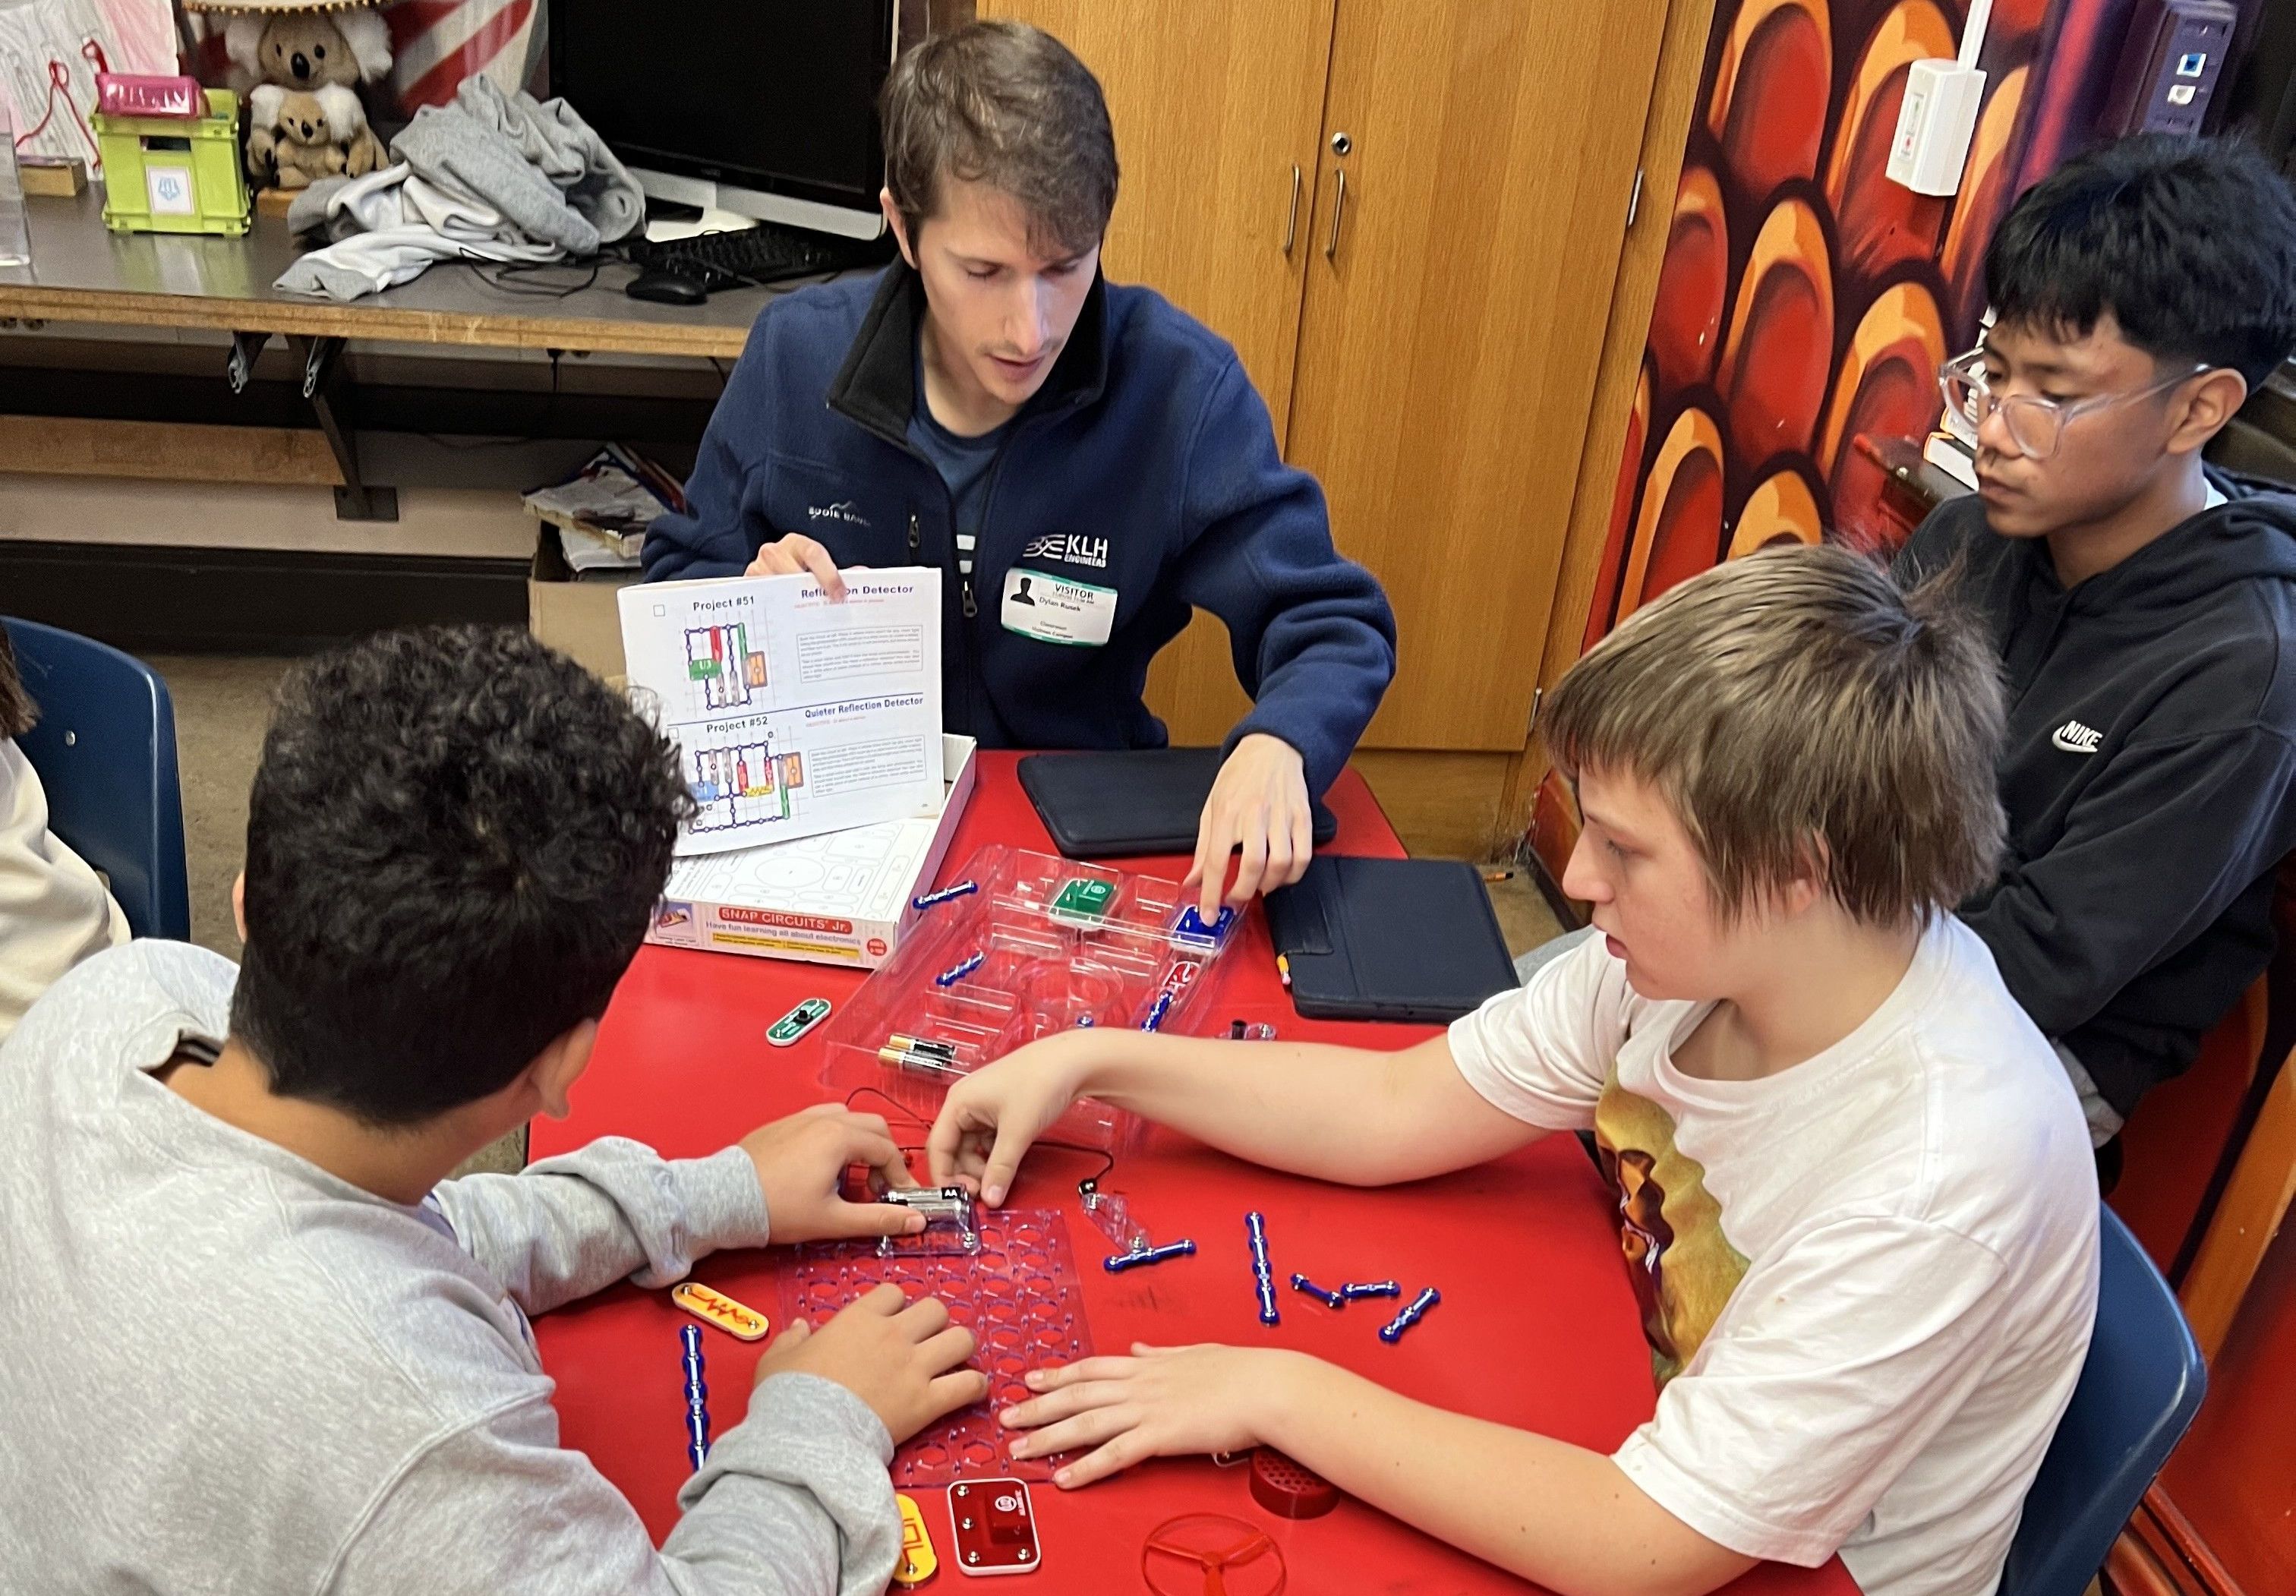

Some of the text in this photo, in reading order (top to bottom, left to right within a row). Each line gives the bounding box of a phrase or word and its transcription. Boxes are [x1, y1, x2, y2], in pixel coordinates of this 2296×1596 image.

[1066, 534, 1108, 559] KLH
[801, 585, 914, 598] Refleon Detector
[1055, 583, 1095, 599] VISITOR
[693, 595, 754, 611] Project #51
[1039, 596, 1059, 607] Dylan
[805, 696, 924, 718] Quieter Reflection Detector
[706, 716, 768, 733] Project #52
[2061, 720, 2103, 747] NIKE
[721, 907, 758, 922] SNAP
[831, 921, 850, 932] Jr.
[705, 921, 727, 931] Have
[728, 923, 742, 932] fun
[743, 924, 777, 937] learning
[790, 929, 814, 940] about
[815, 933, 861, 945] electronics
[945, 1189, 957, 1197] AA
